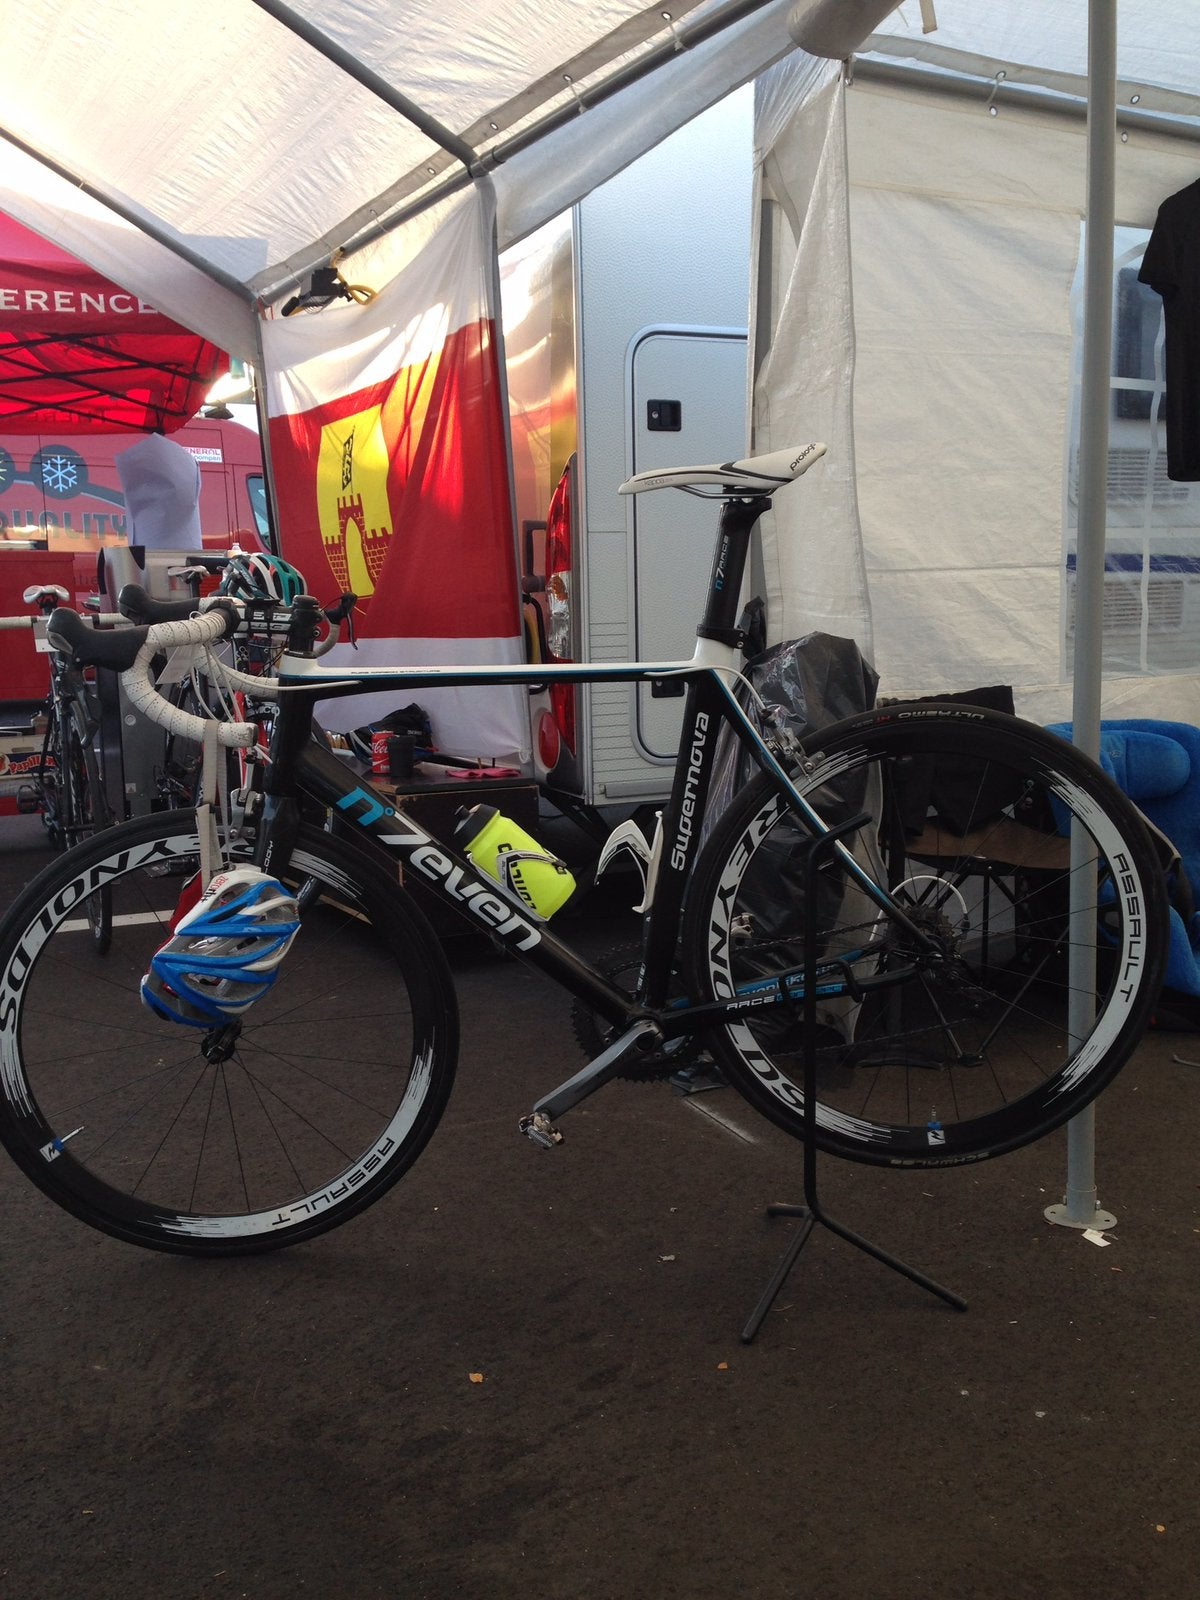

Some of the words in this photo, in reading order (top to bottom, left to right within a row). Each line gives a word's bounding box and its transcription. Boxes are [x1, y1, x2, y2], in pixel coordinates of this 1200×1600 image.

[671, 711, 710, 871] Supernova
[1113, 853, 1142, 1004] ASSAULT
[272, 1137, 395, 1226] ASSAULT
